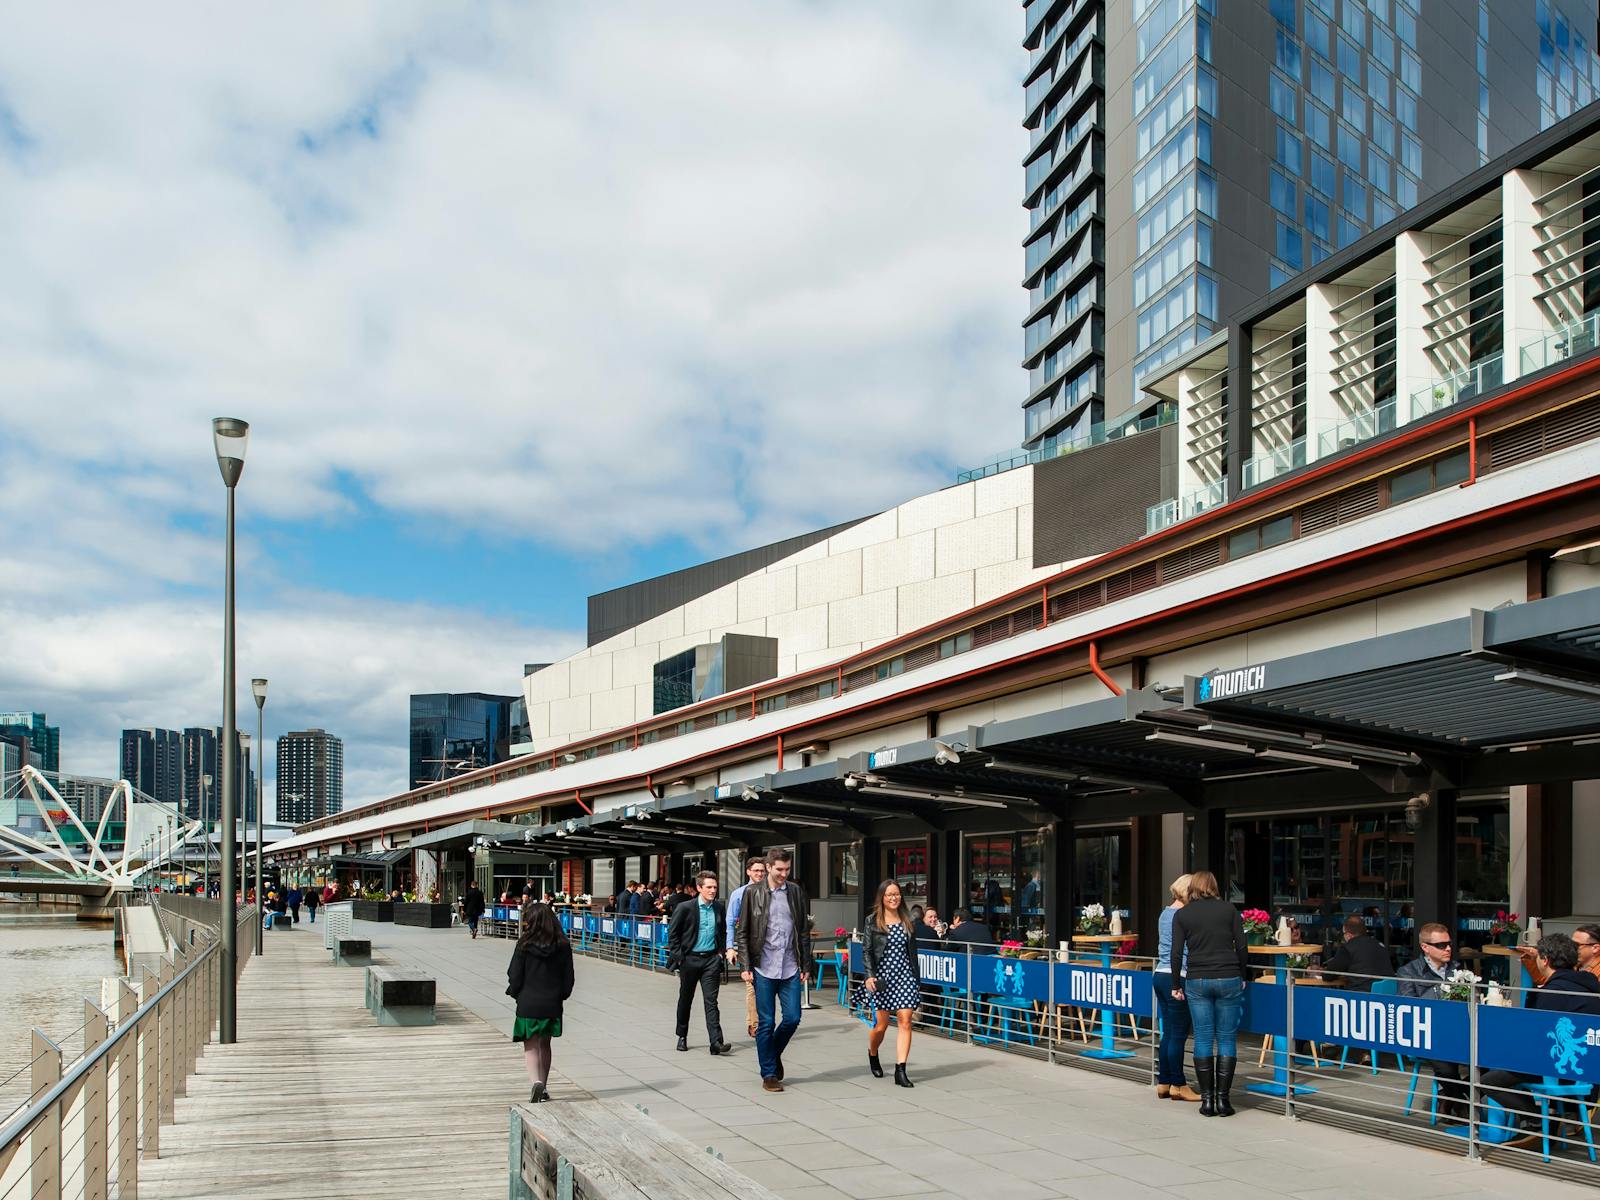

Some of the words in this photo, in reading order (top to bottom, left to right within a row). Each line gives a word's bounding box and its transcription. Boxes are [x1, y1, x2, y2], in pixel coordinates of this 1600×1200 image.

[1212, 666, 1265, 698] MUNICH
[1071, 970, 1133, 1008] MUNICH
[1325, 997, 1431, 1050] MUNICH
[1387, 1003, 1395, 1045] BRAUHAUS
